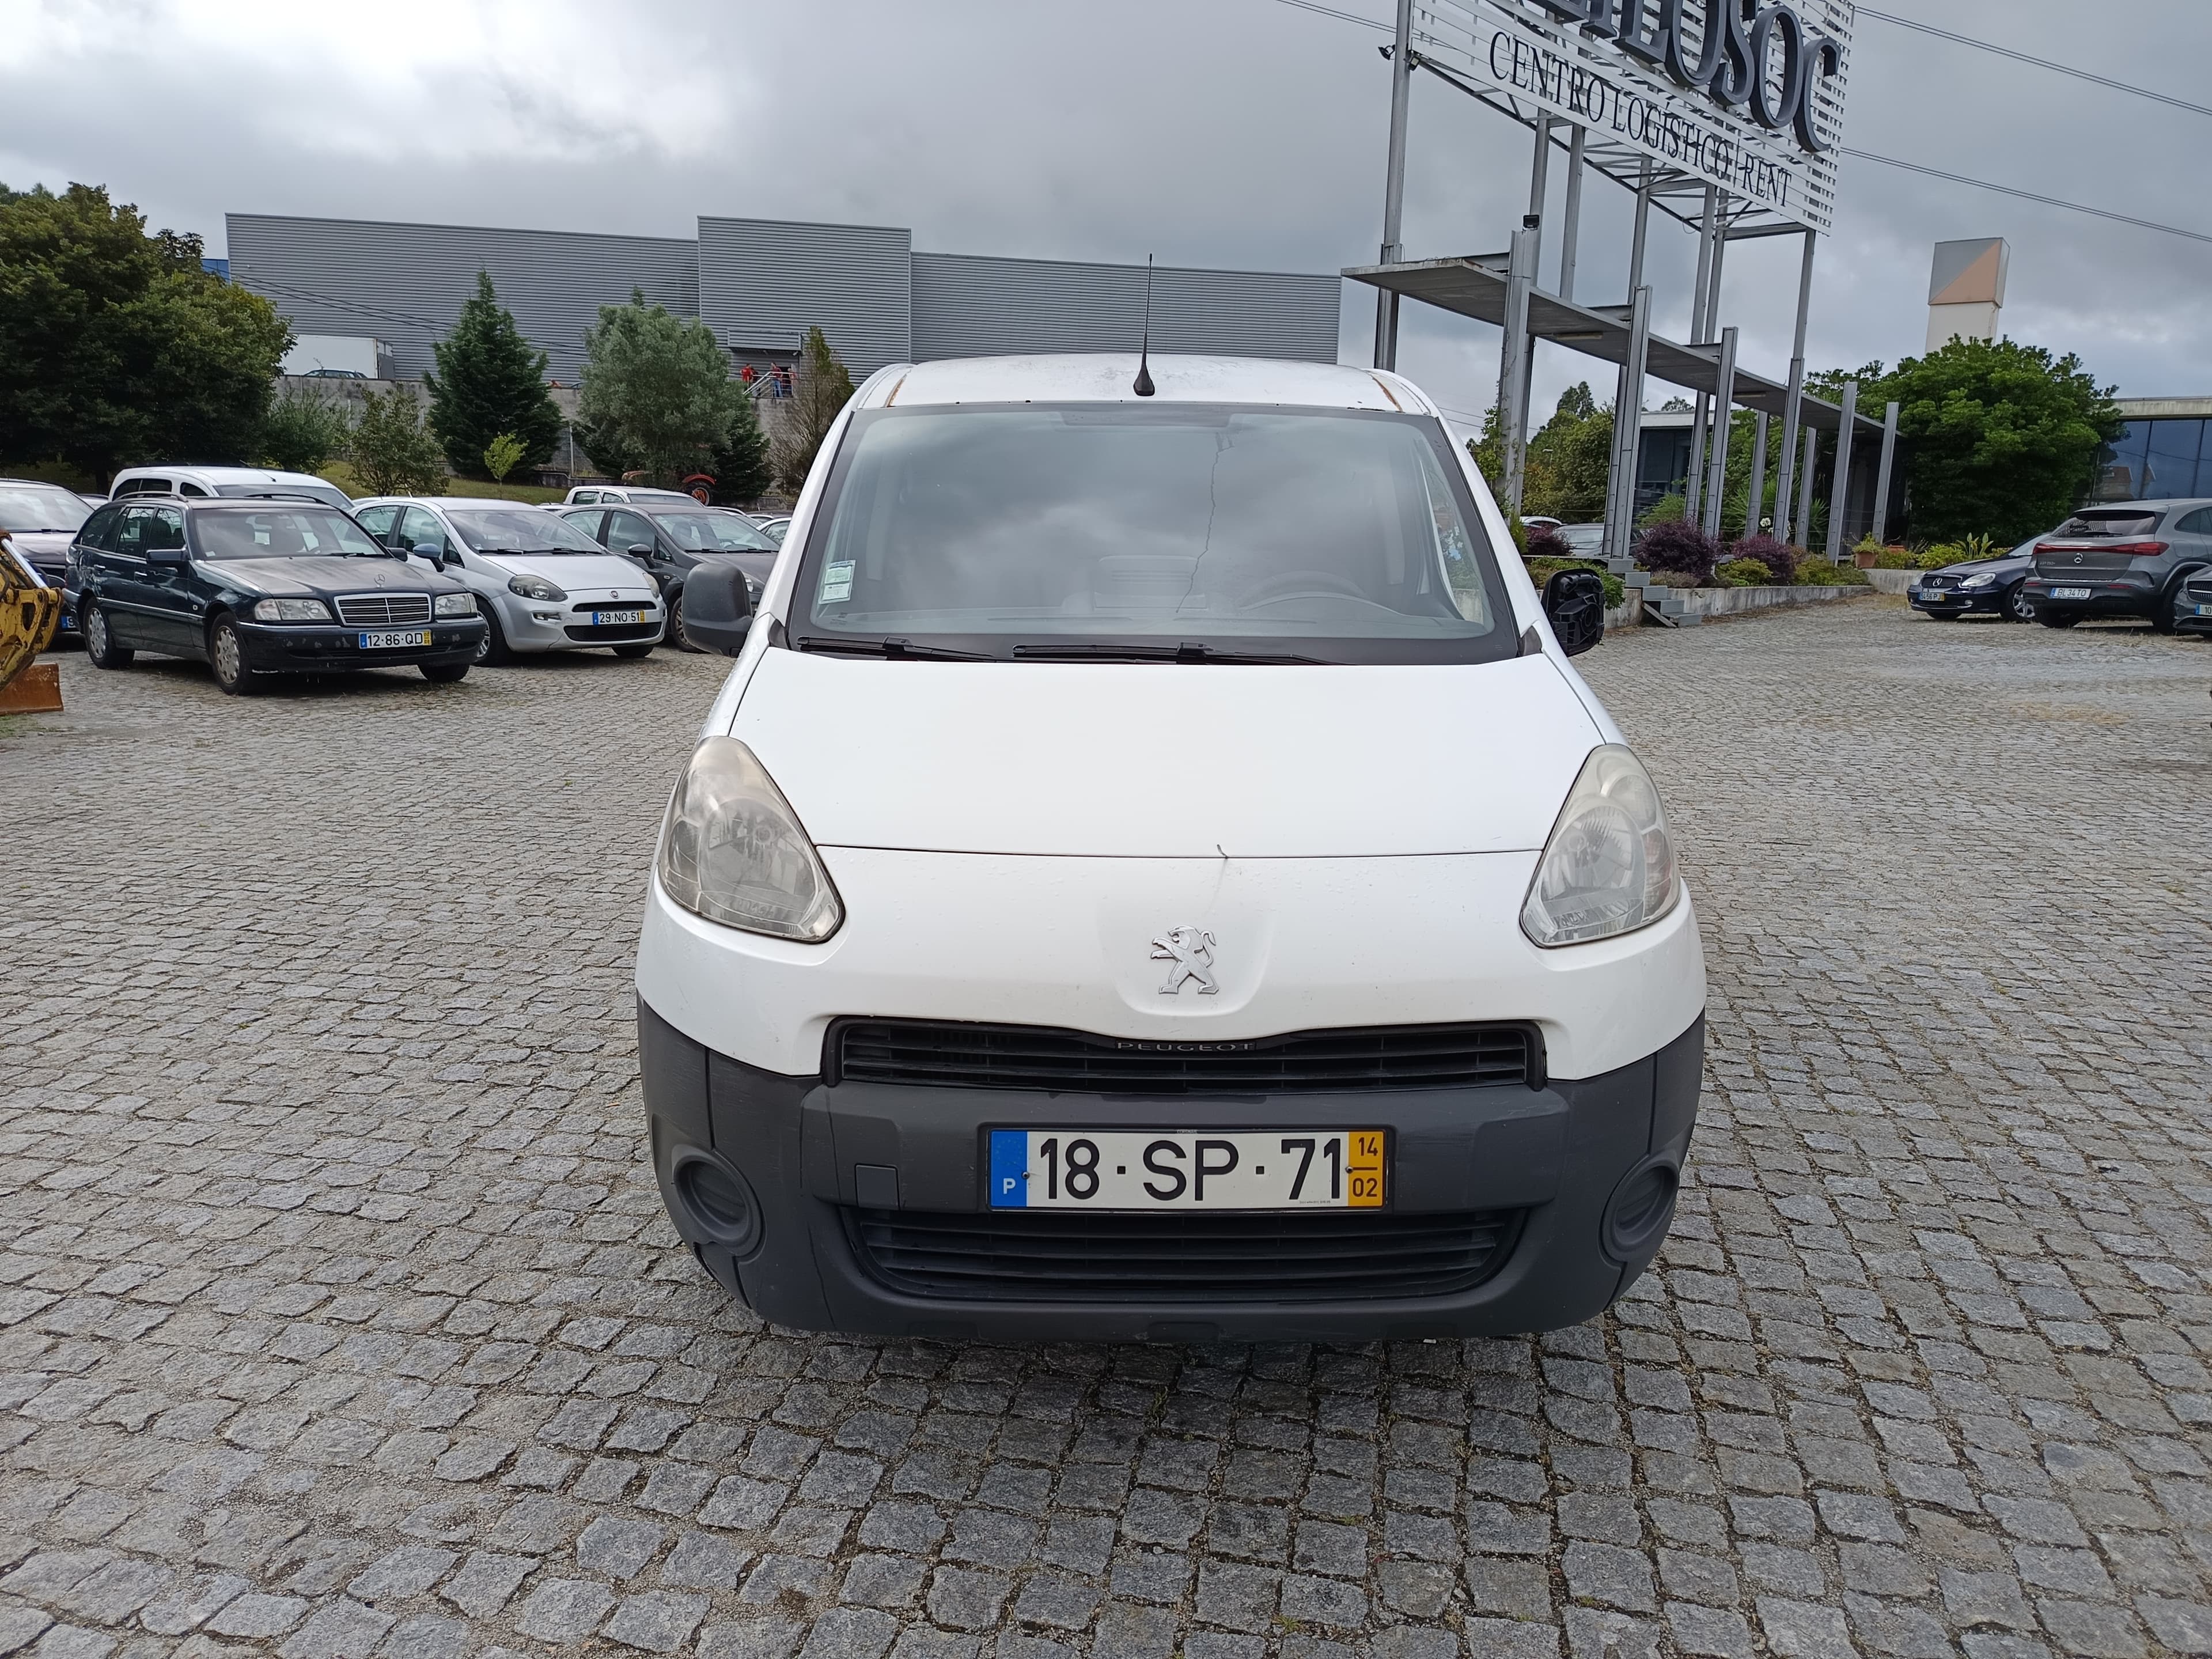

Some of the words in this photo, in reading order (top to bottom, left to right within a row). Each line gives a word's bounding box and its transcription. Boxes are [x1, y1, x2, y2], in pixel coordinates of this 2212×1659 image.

[1490, 31, 1605, 122] CENTRO
[1610, 89, 1730, 180] LOGÍSTICO
[1741, 151, 1791, 207] RENT
[1117, 1042, 1253, 1051] PEUGEOT
[1358, 1137, 1378, 1156] 14
[1003, 1178, 1016, 1195] P
[1353, 1178, 1378, 1197] 02
